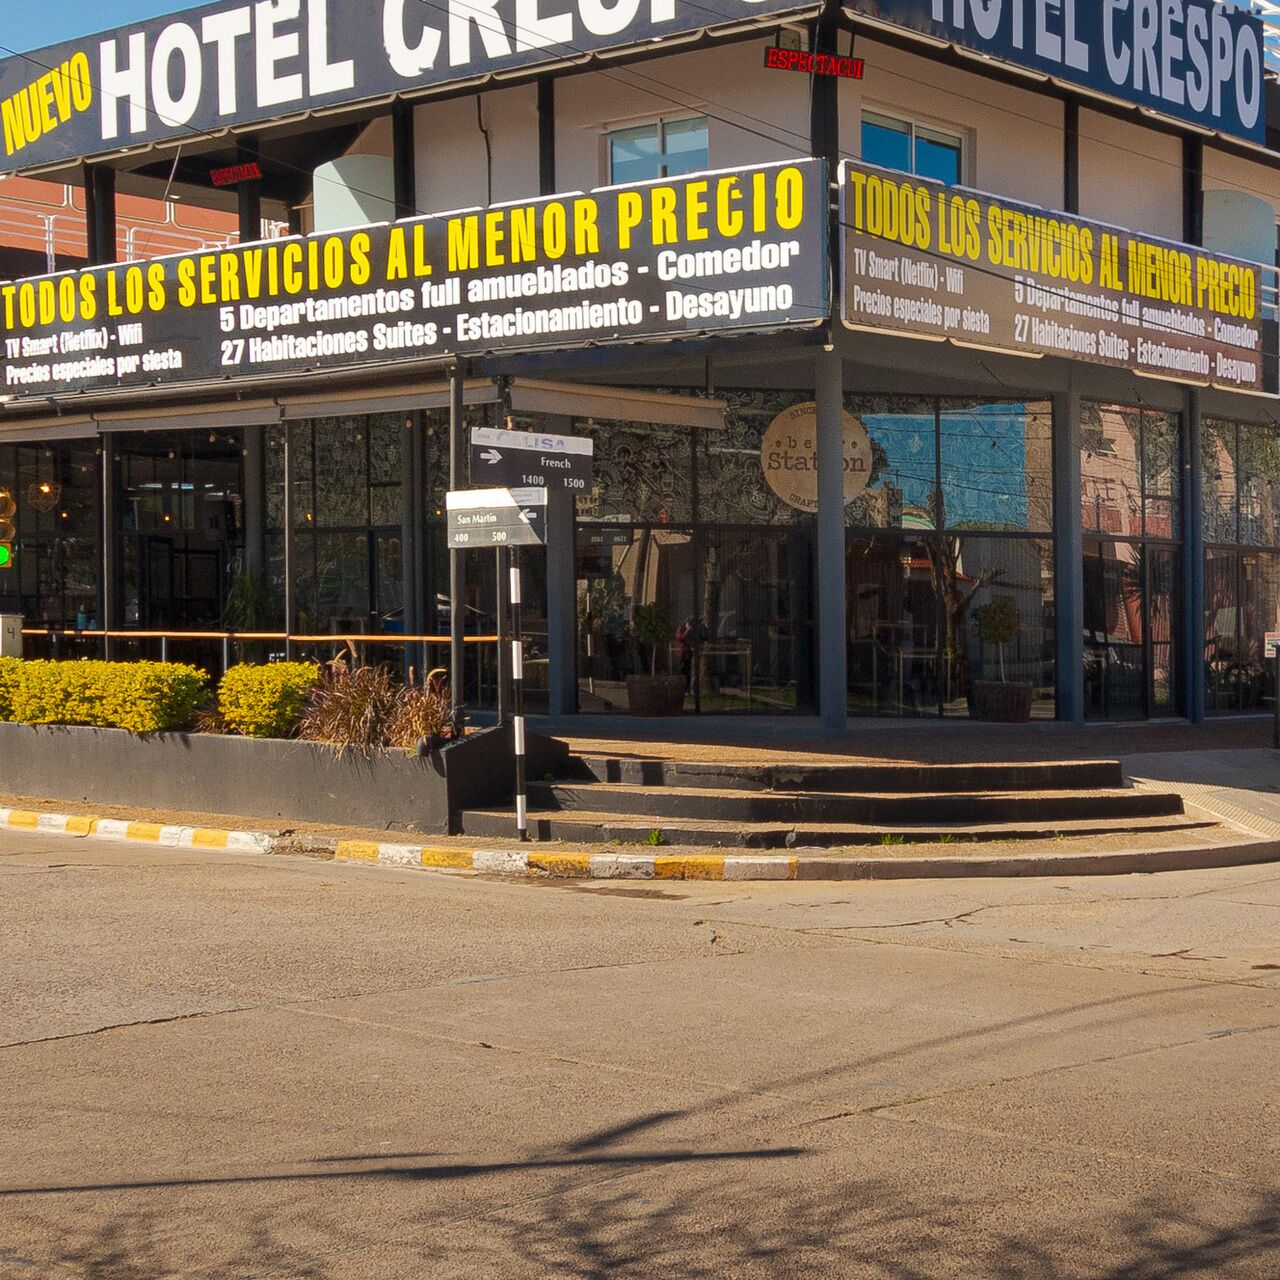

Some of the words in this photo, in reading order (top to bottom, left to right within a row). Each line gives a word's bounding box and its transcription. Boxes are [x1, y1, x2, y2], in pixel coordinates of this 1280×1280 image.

[1, 51, 93, 156] NUEVO
[1, 273, 97, 330] TODOS
[108, 262, 167, 317] LOS
[177, 232, 372, 308] SERVICIOS
[386, 224, 432, 280] AL
[447, 198, 600, 273] MENOR
[617, 167, 804, 251] PRECIO
[850, 170, 931, 250] TODOS
[938, 192, 981, 261] LOS
[988, 204, 1094, 286] SERVICIOS
[1099, 233, 1123, 292] AL
[1127, 240, 1193, 307] MENOR
[1197, 256, 1255, 320] PRECIO
[219, 306, 235, 332] 5
[239, 288, 415, 332] Departamentos
[421, 277, 461, 309] full
[467, 260, 629, 303] amueblados
[657, 239, 800, 281] Comedor
[854, 248, 867, 276] TV
[869, 251, 899, 282] Smart
[901, 257, 938, 291] (Netflix)
[946, 266, 964, 295] Wifi
[220, 338, 245, 366] 27
[249, 329, 368, 363] Habitaciones
[372, 321, 438, 351] Suites
[456, 295, 643, 342] Estacionamiento
[665, 283, 793, 322] Desayuno
[853, 285, 892, 318] Precios
[893, 296, 942, 325] especiales
[944, 306, 961, 331] por
[962, 306, 990, 334] siesta
[1014, 275, 1024, 304] 5
[1026, 277, 1119, 322] Departamentos
[1121, 298, 1140, 326] full
[1142, 306, 1205, 338] amueblados
[1213, 317, 1258, 350] Comedor
[5, 337, 20, 359] TV
[22, 334, 58, 357] Smart
[59, 327, 108, 354] (Netflix)
[117, 322, 143, 346] Wifi
[1014, 313, 1029, 343] 27
[1031, 317, 1097, 356] Habitaciones
[1098, 330, 1129, 361] Suites
[1136, 336, 1210, 375] Estacionamiento
[1216, 352, 1256, 384] Desayuno
[6, 363, 50, 385] Precios
[52, 356, 115, 383] especiales
[116, 354, 140, 377] por
[142, 348, 183, 371] siesta
[521, 474, 545, 485] 1400
[563, 477, 585, 489] 1500
[541, 456, 571, 469] French
[767, 451, 866, 472] Staton
[454, 533, 469, 543] 400
[492, 531, 507, 542] 500
[457, 515, 471, 525] San
